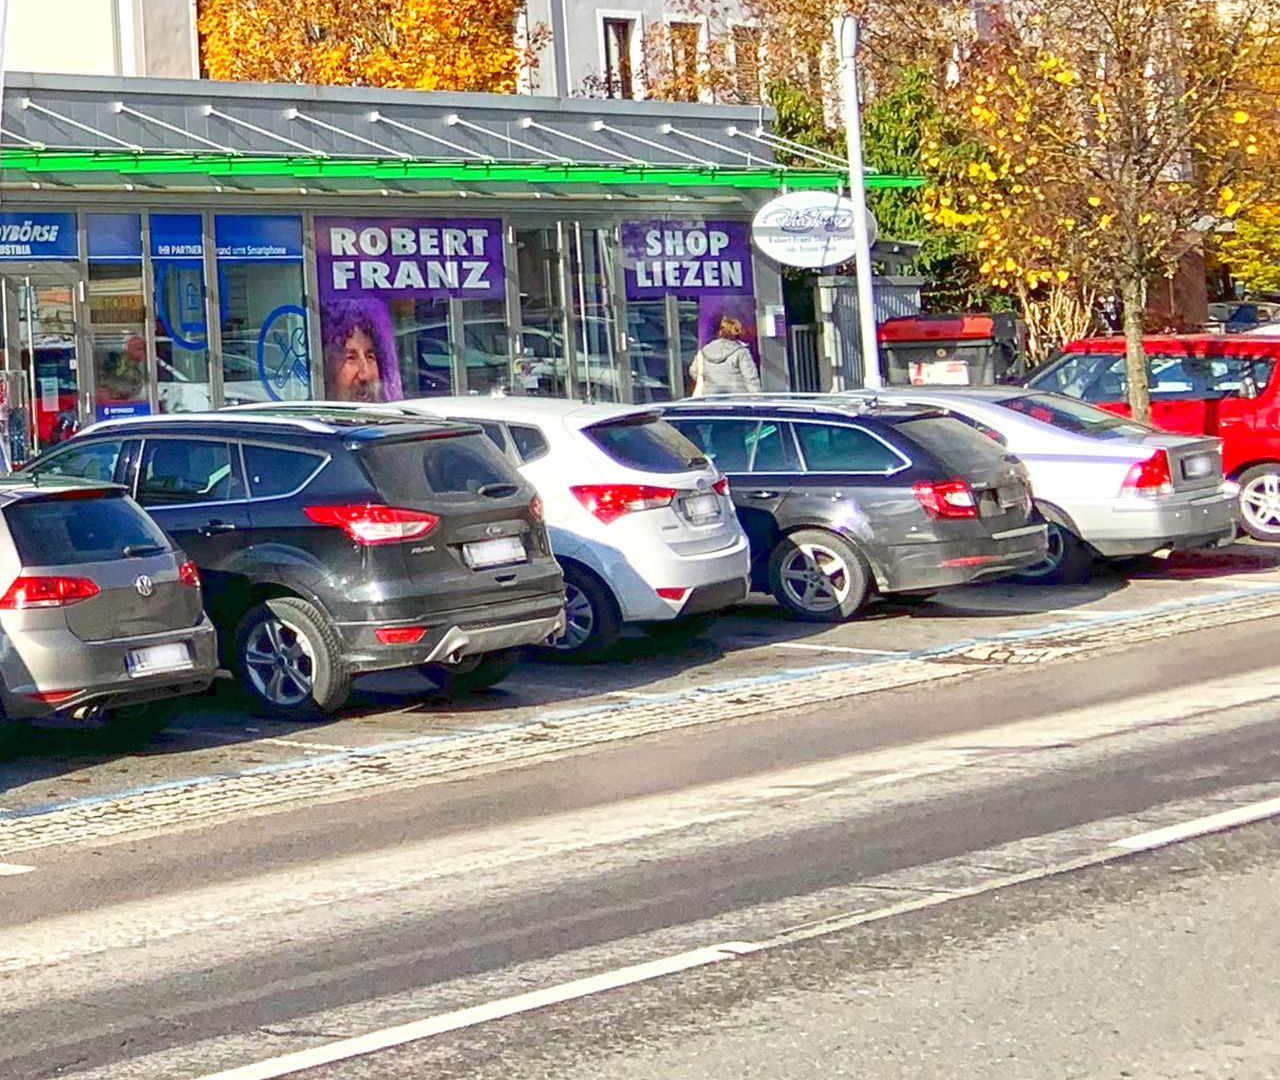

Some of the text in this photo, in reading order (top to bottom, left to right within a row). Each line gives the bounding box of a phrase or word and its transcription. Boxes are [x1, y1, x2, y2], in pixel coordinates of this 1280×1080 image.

[158, 245, 170, 255] IHR
[171, 245, 202, 255] PARTNER
[247, 245, 287, 256] Smartphone
[330, 227, 489, 256] ROBERT
[645, 229, 729, 257] SHOP
[332, 260, 490, 289] FRANZ
[636, 260, 743, 288] LIEZEN
